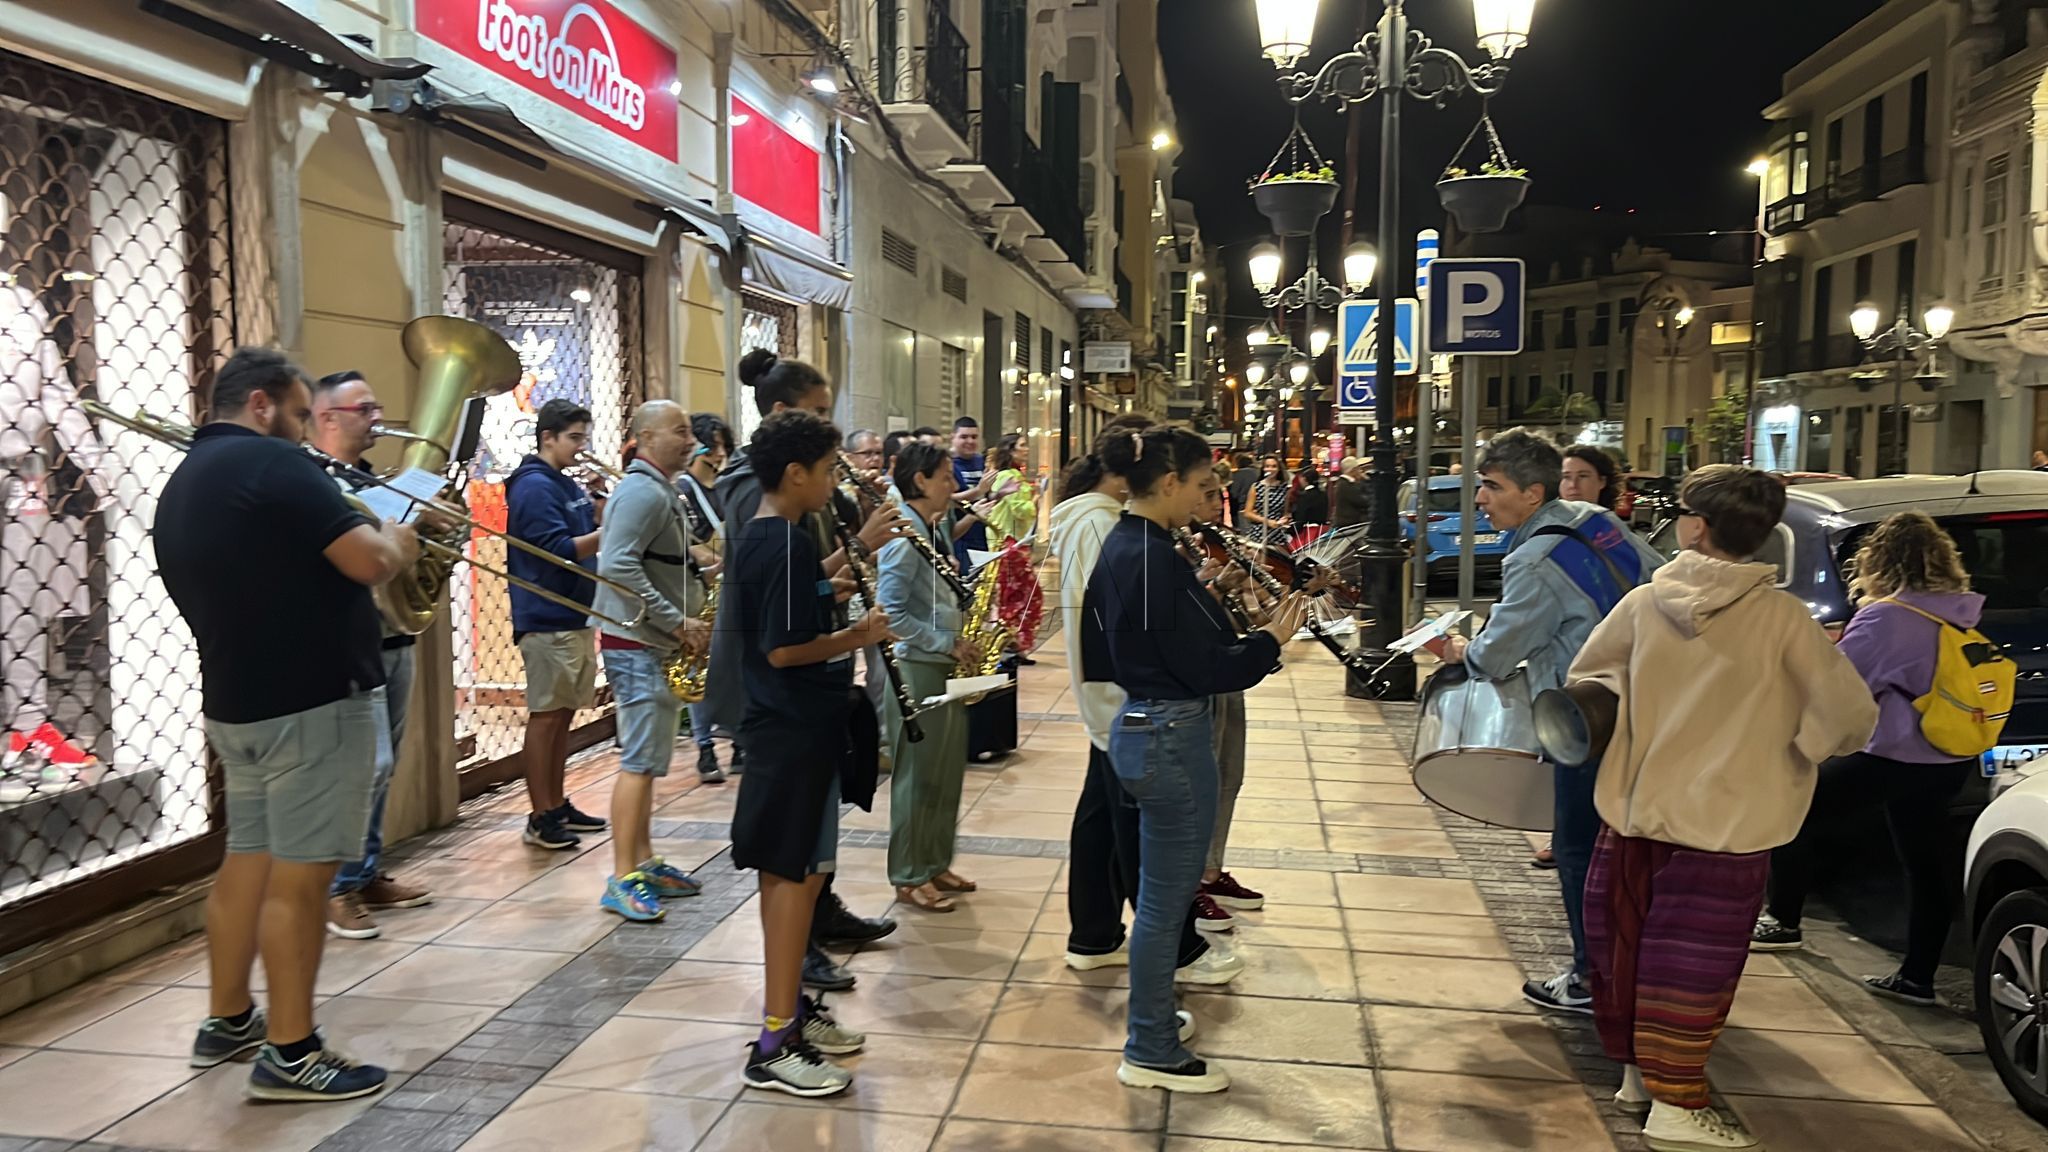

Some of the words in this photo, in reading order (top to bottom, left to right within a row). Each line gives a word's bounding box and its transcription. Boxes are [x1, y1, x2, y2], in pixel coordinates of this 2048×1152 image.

[478, 0, 548, 78] Foot
[548, 37, 586, 99] on
[585, 48, 645, 131] Mars
[1446, 270, 1504, 343] P
